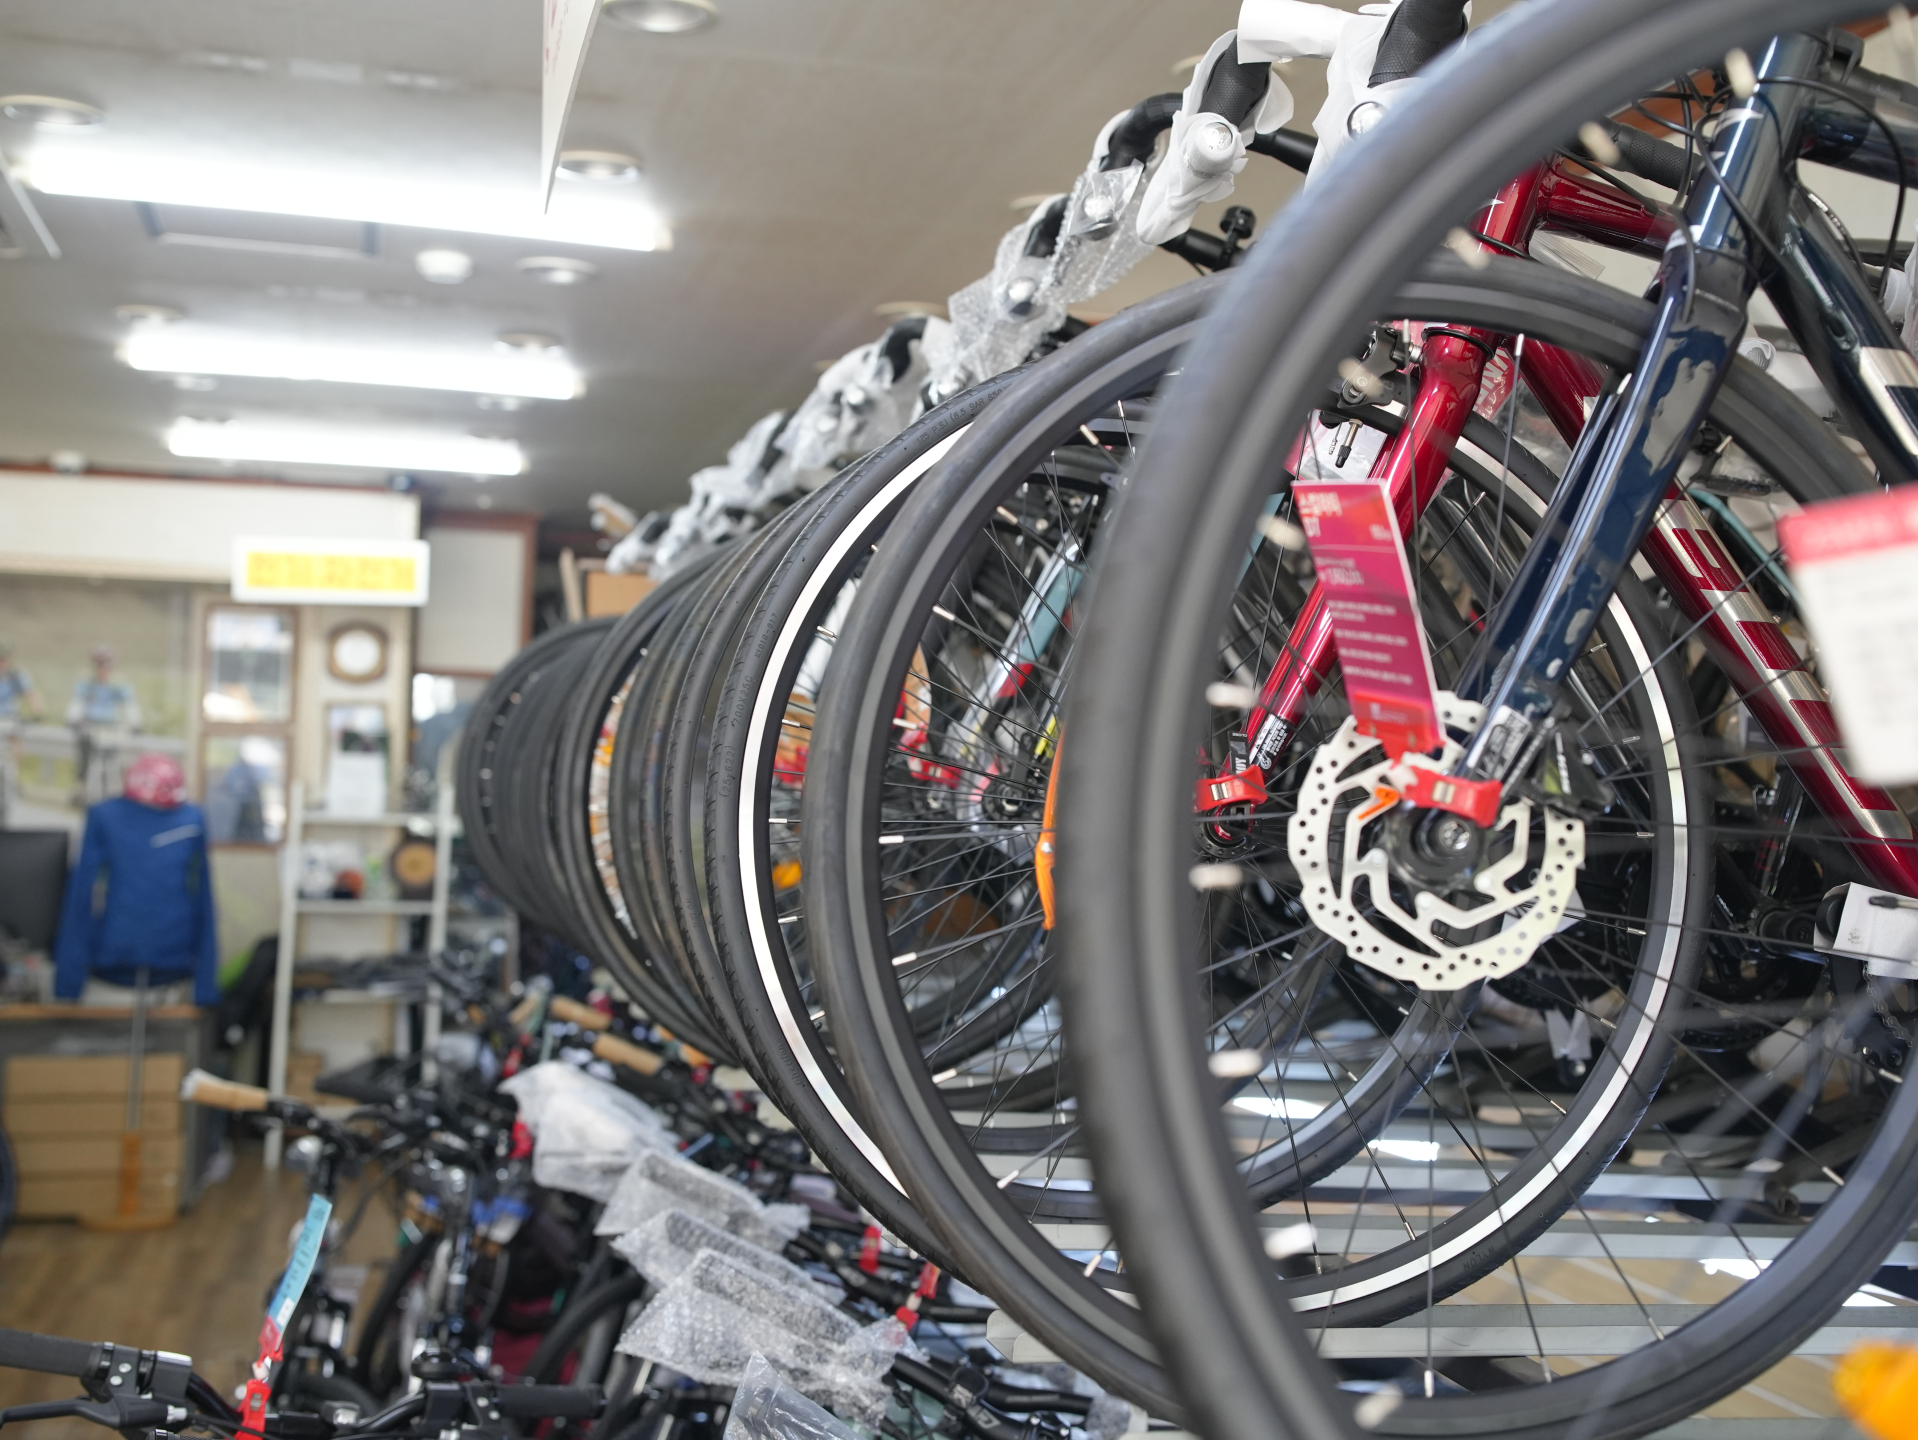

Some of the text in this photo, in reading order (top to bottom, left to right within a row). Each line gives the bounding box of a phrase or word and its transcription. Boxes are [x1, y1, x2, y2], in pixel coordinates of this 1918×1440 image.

[948, 407, 967, 422] (8.5
[968, 397, 984, 411] BAR
[732, 675, 753, 723] 700X25C
[721, 745, 736, 798] (25-622)
[685, 898, 699, 927] NYLON
[1462, 1245, 1495, 1271] NYLON
